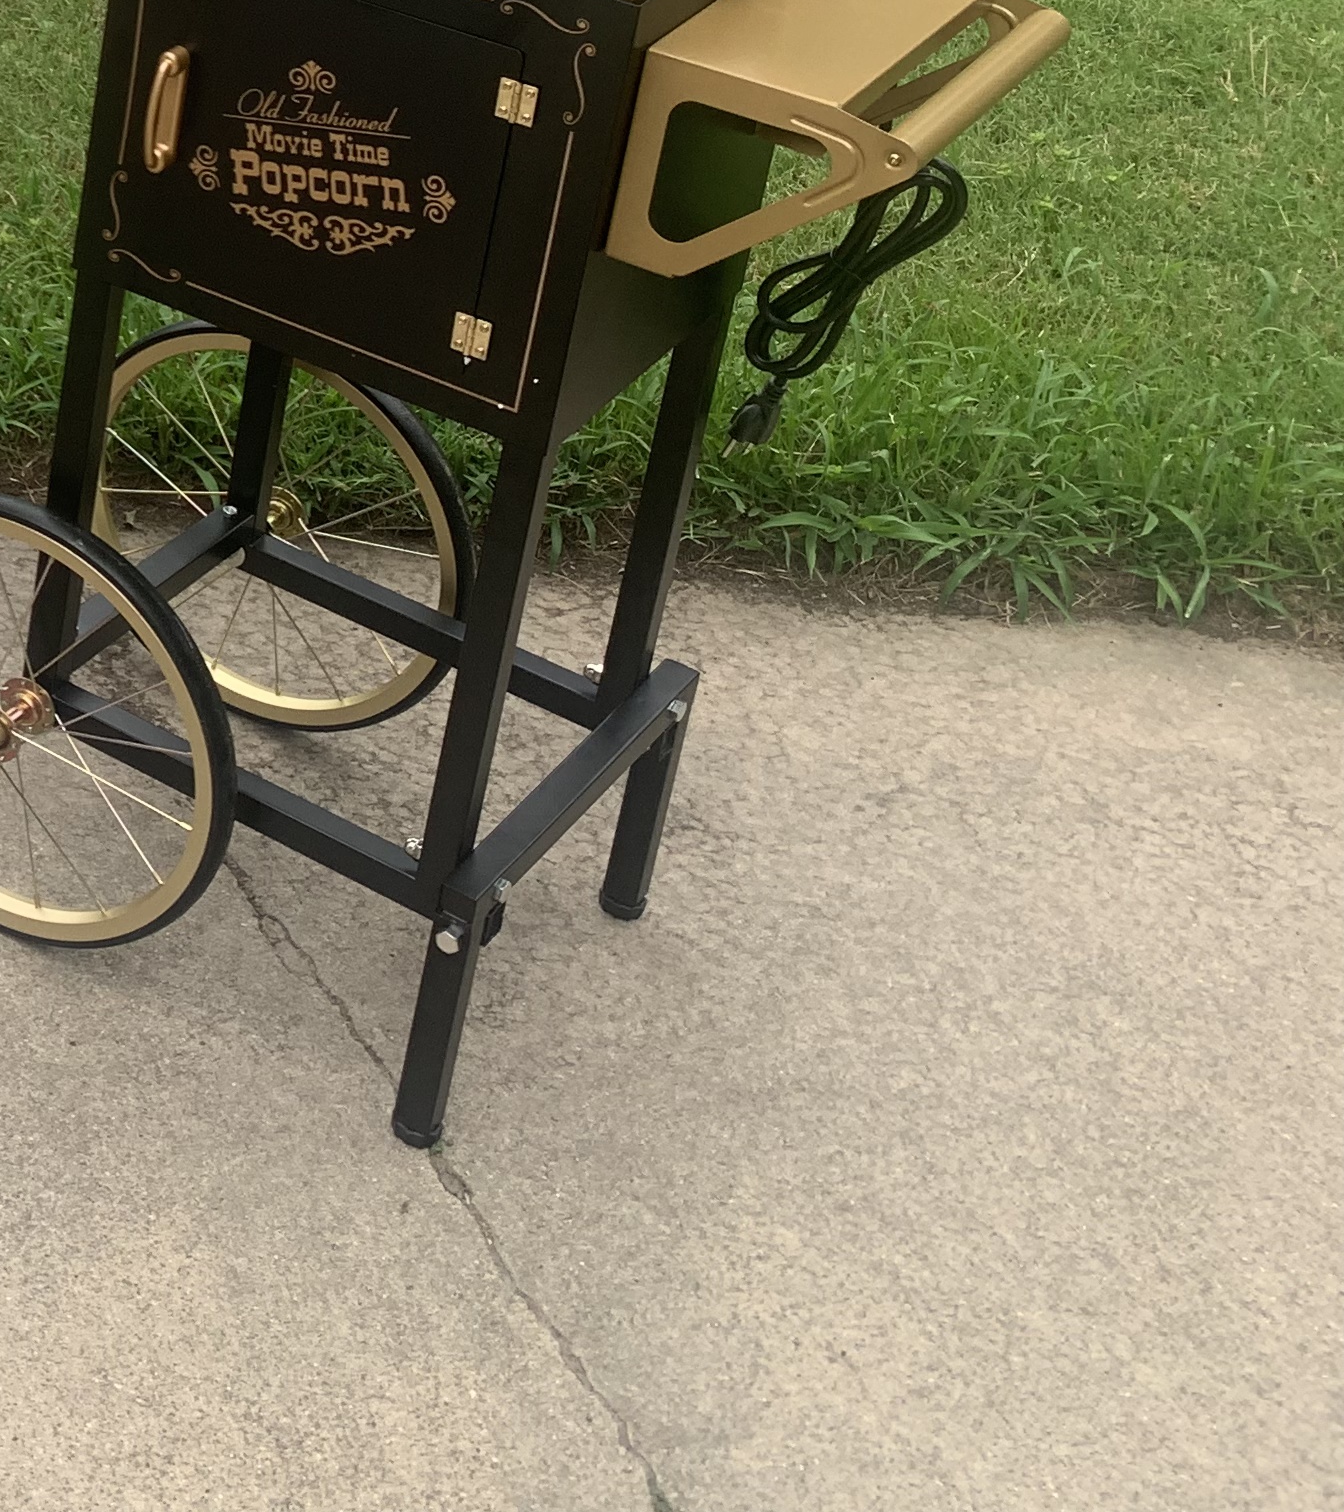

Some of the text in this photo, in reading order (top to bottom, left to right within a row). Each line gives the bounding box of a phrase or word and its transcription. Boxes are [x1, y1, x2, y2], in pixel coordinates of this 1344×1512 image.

[236, 88, 400, 133] Old Fashioned
[244, 122, 391, 168] Movie Time
[229, 147, 412, 214] Popcorn
